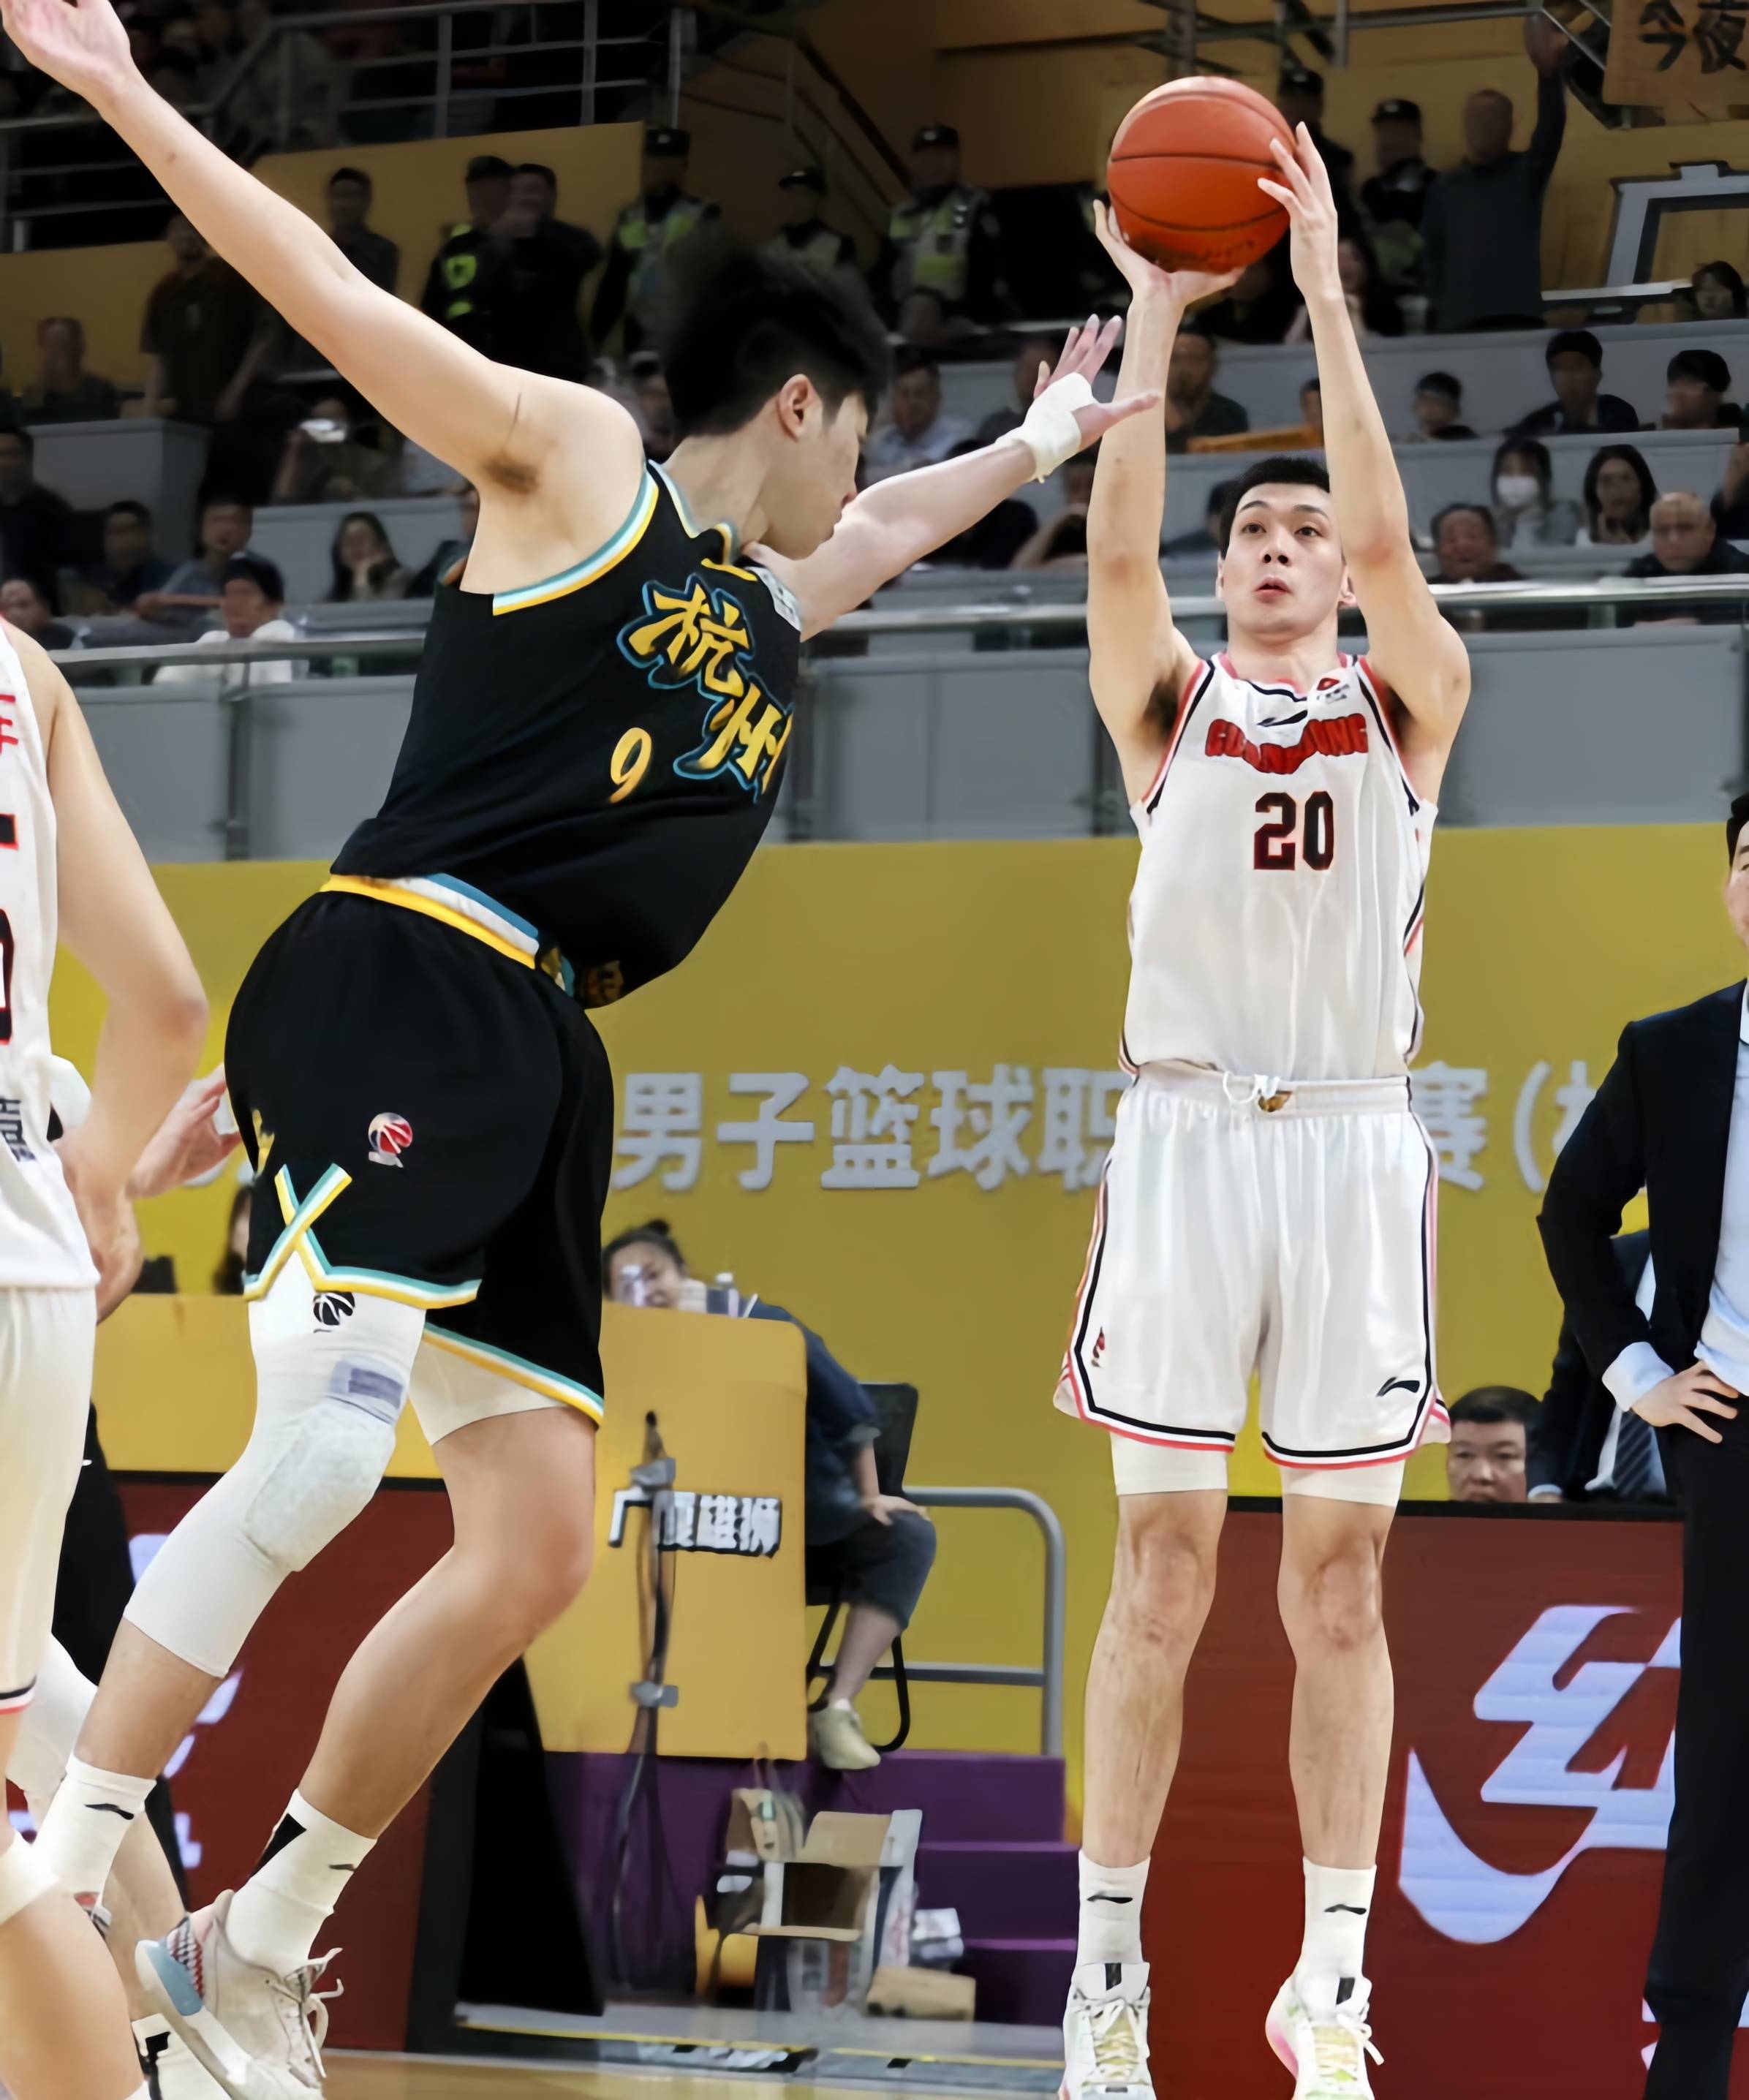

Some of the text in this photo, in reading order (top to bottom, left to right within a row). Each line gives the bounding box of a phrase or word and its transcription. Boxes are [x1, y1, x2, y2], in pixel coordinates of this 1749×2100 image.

[616, 573, 794, 805] 杭州
[608, 727, 653, 804] 9
[1253, 790, 1334, 870] 20
